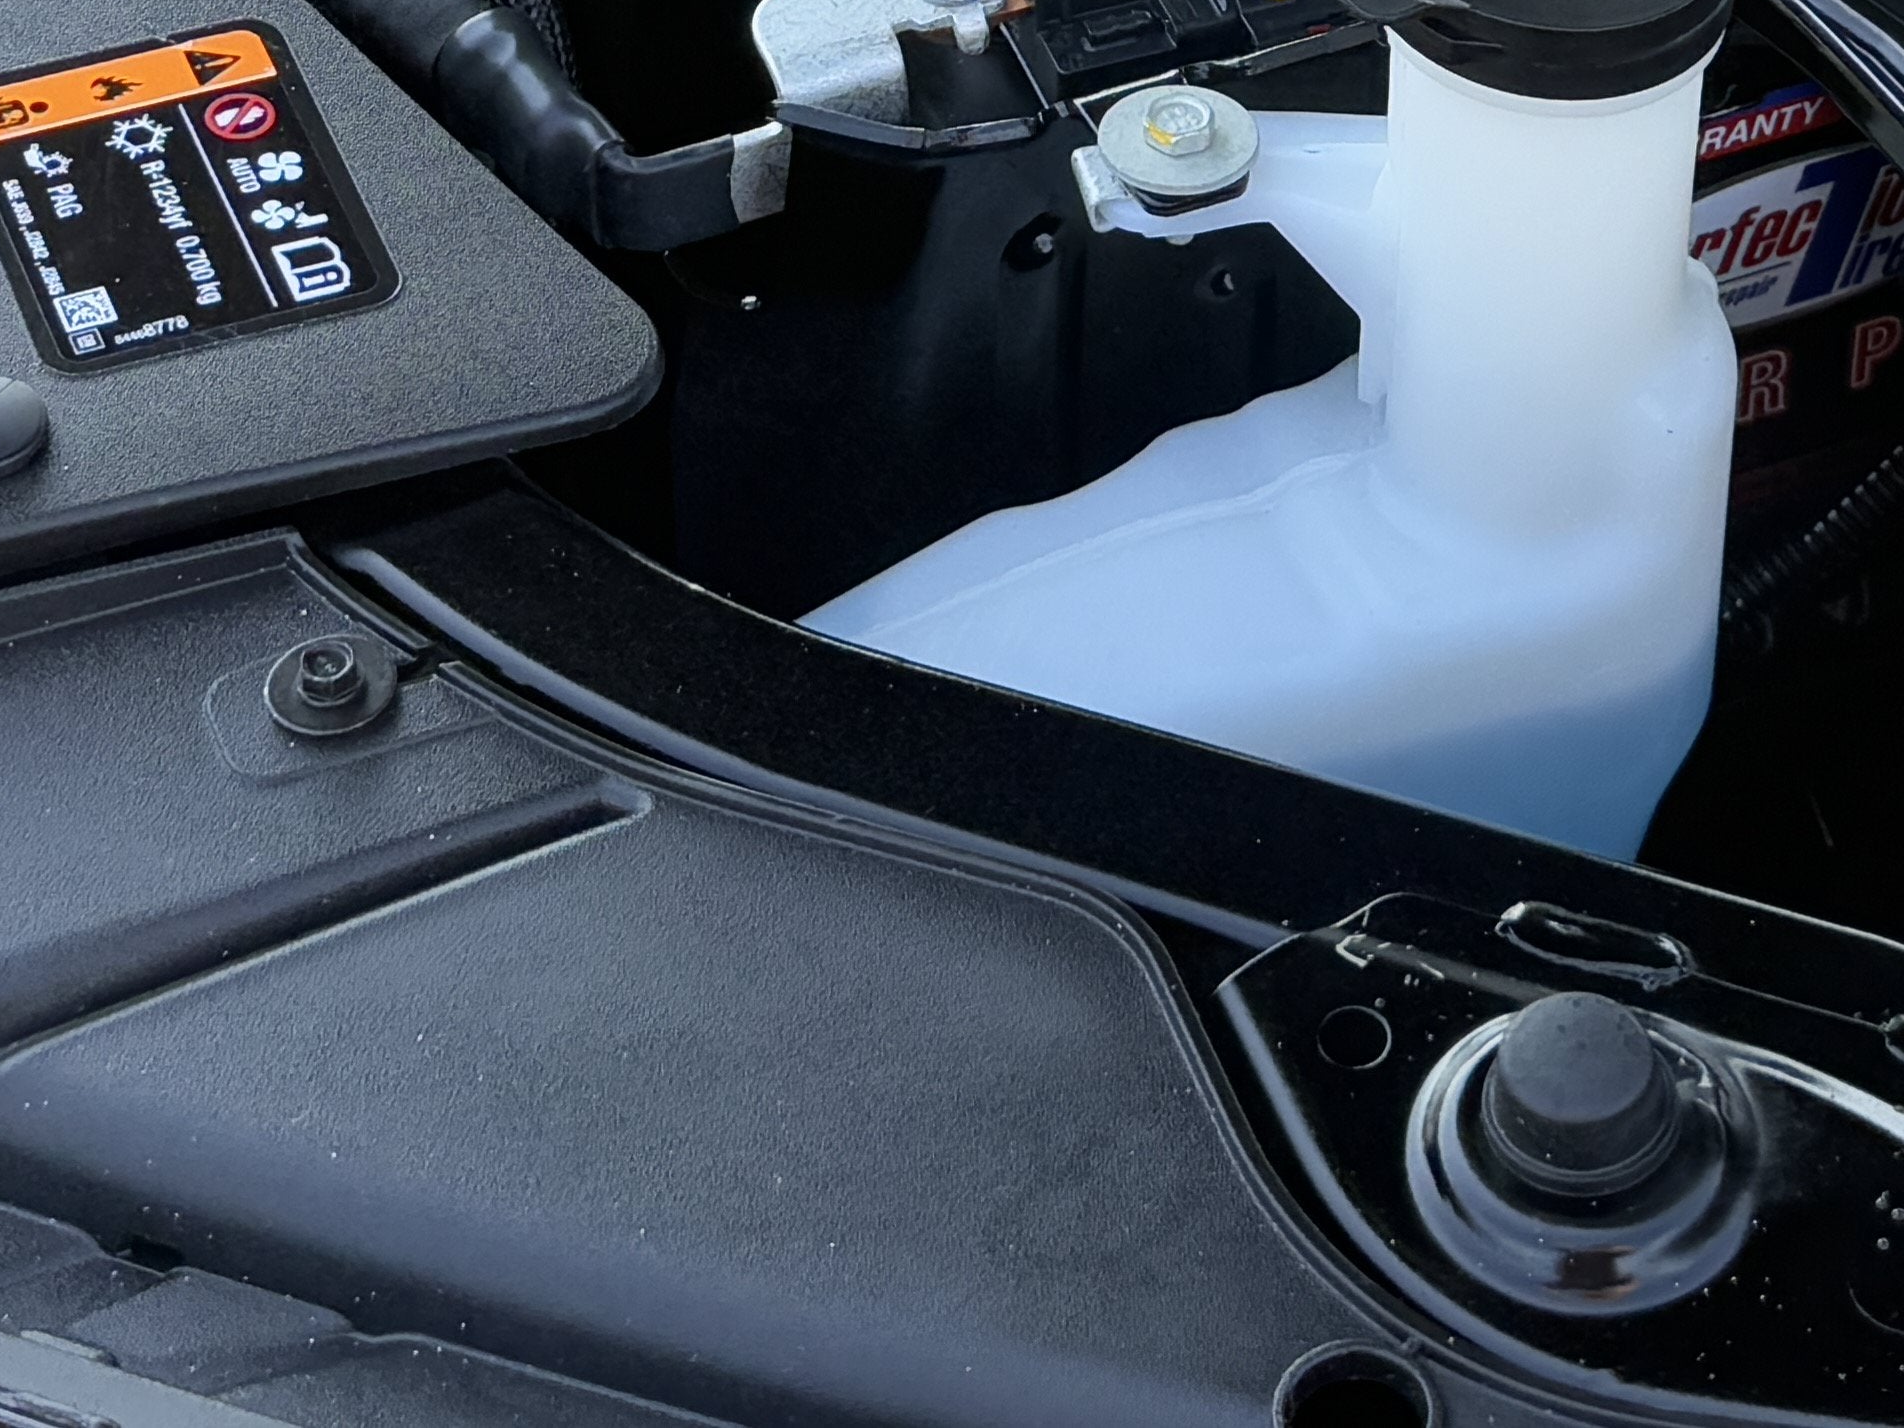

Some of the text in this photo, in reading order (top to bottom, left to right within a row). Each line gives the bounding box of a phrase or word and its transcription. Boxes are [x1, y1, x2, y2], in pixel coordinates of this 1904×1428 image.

[1700, 97, 1824, 155] RANTY
[2, 179, 24, 200] SAE
[227, 157, 261, 194] AUTO
[47, 183, 83, 219] PAG
[140, 159, 222, 305] R-1234yf 0.700 kg
